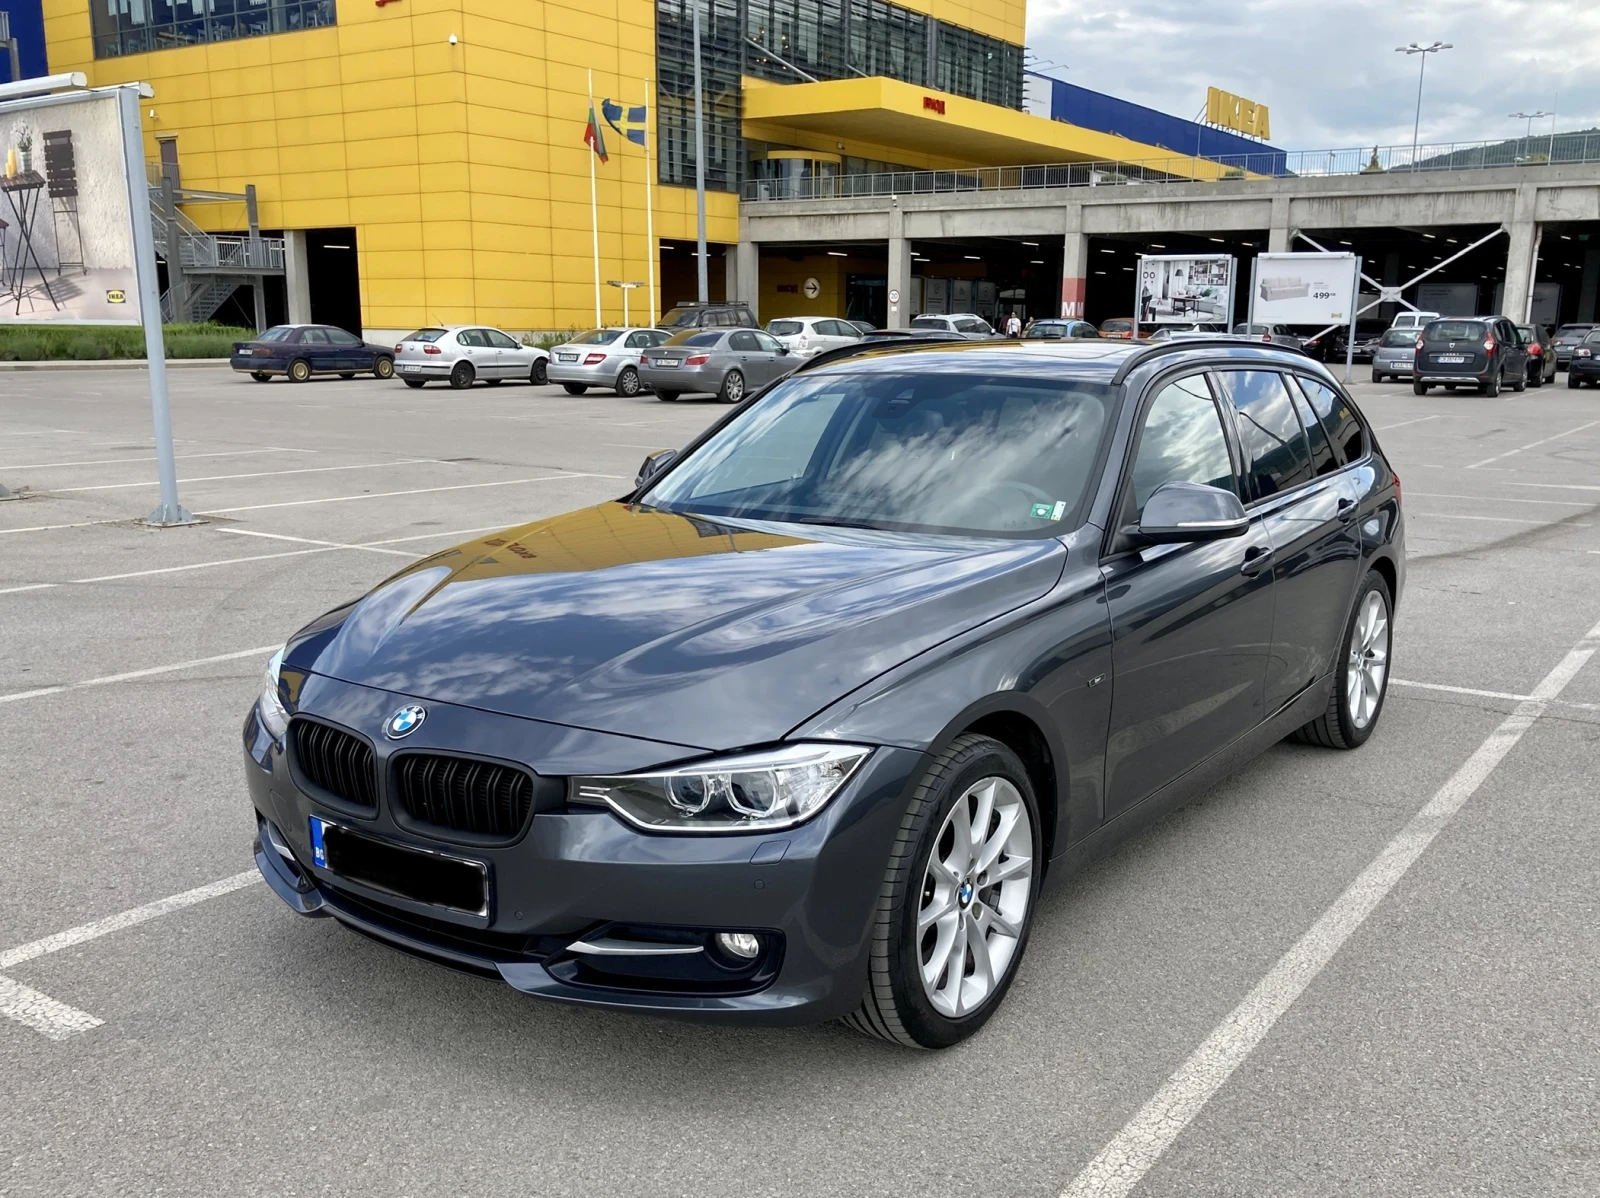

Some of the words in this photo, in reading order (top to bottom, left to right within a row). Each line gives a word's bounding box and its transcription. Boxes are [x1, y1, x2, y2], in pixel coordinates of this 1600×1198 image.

[1206, 86, 1270, 141] IKEA
[1313, 292, 1330, 300] 499
[1062, 301, 1076, 317] M
